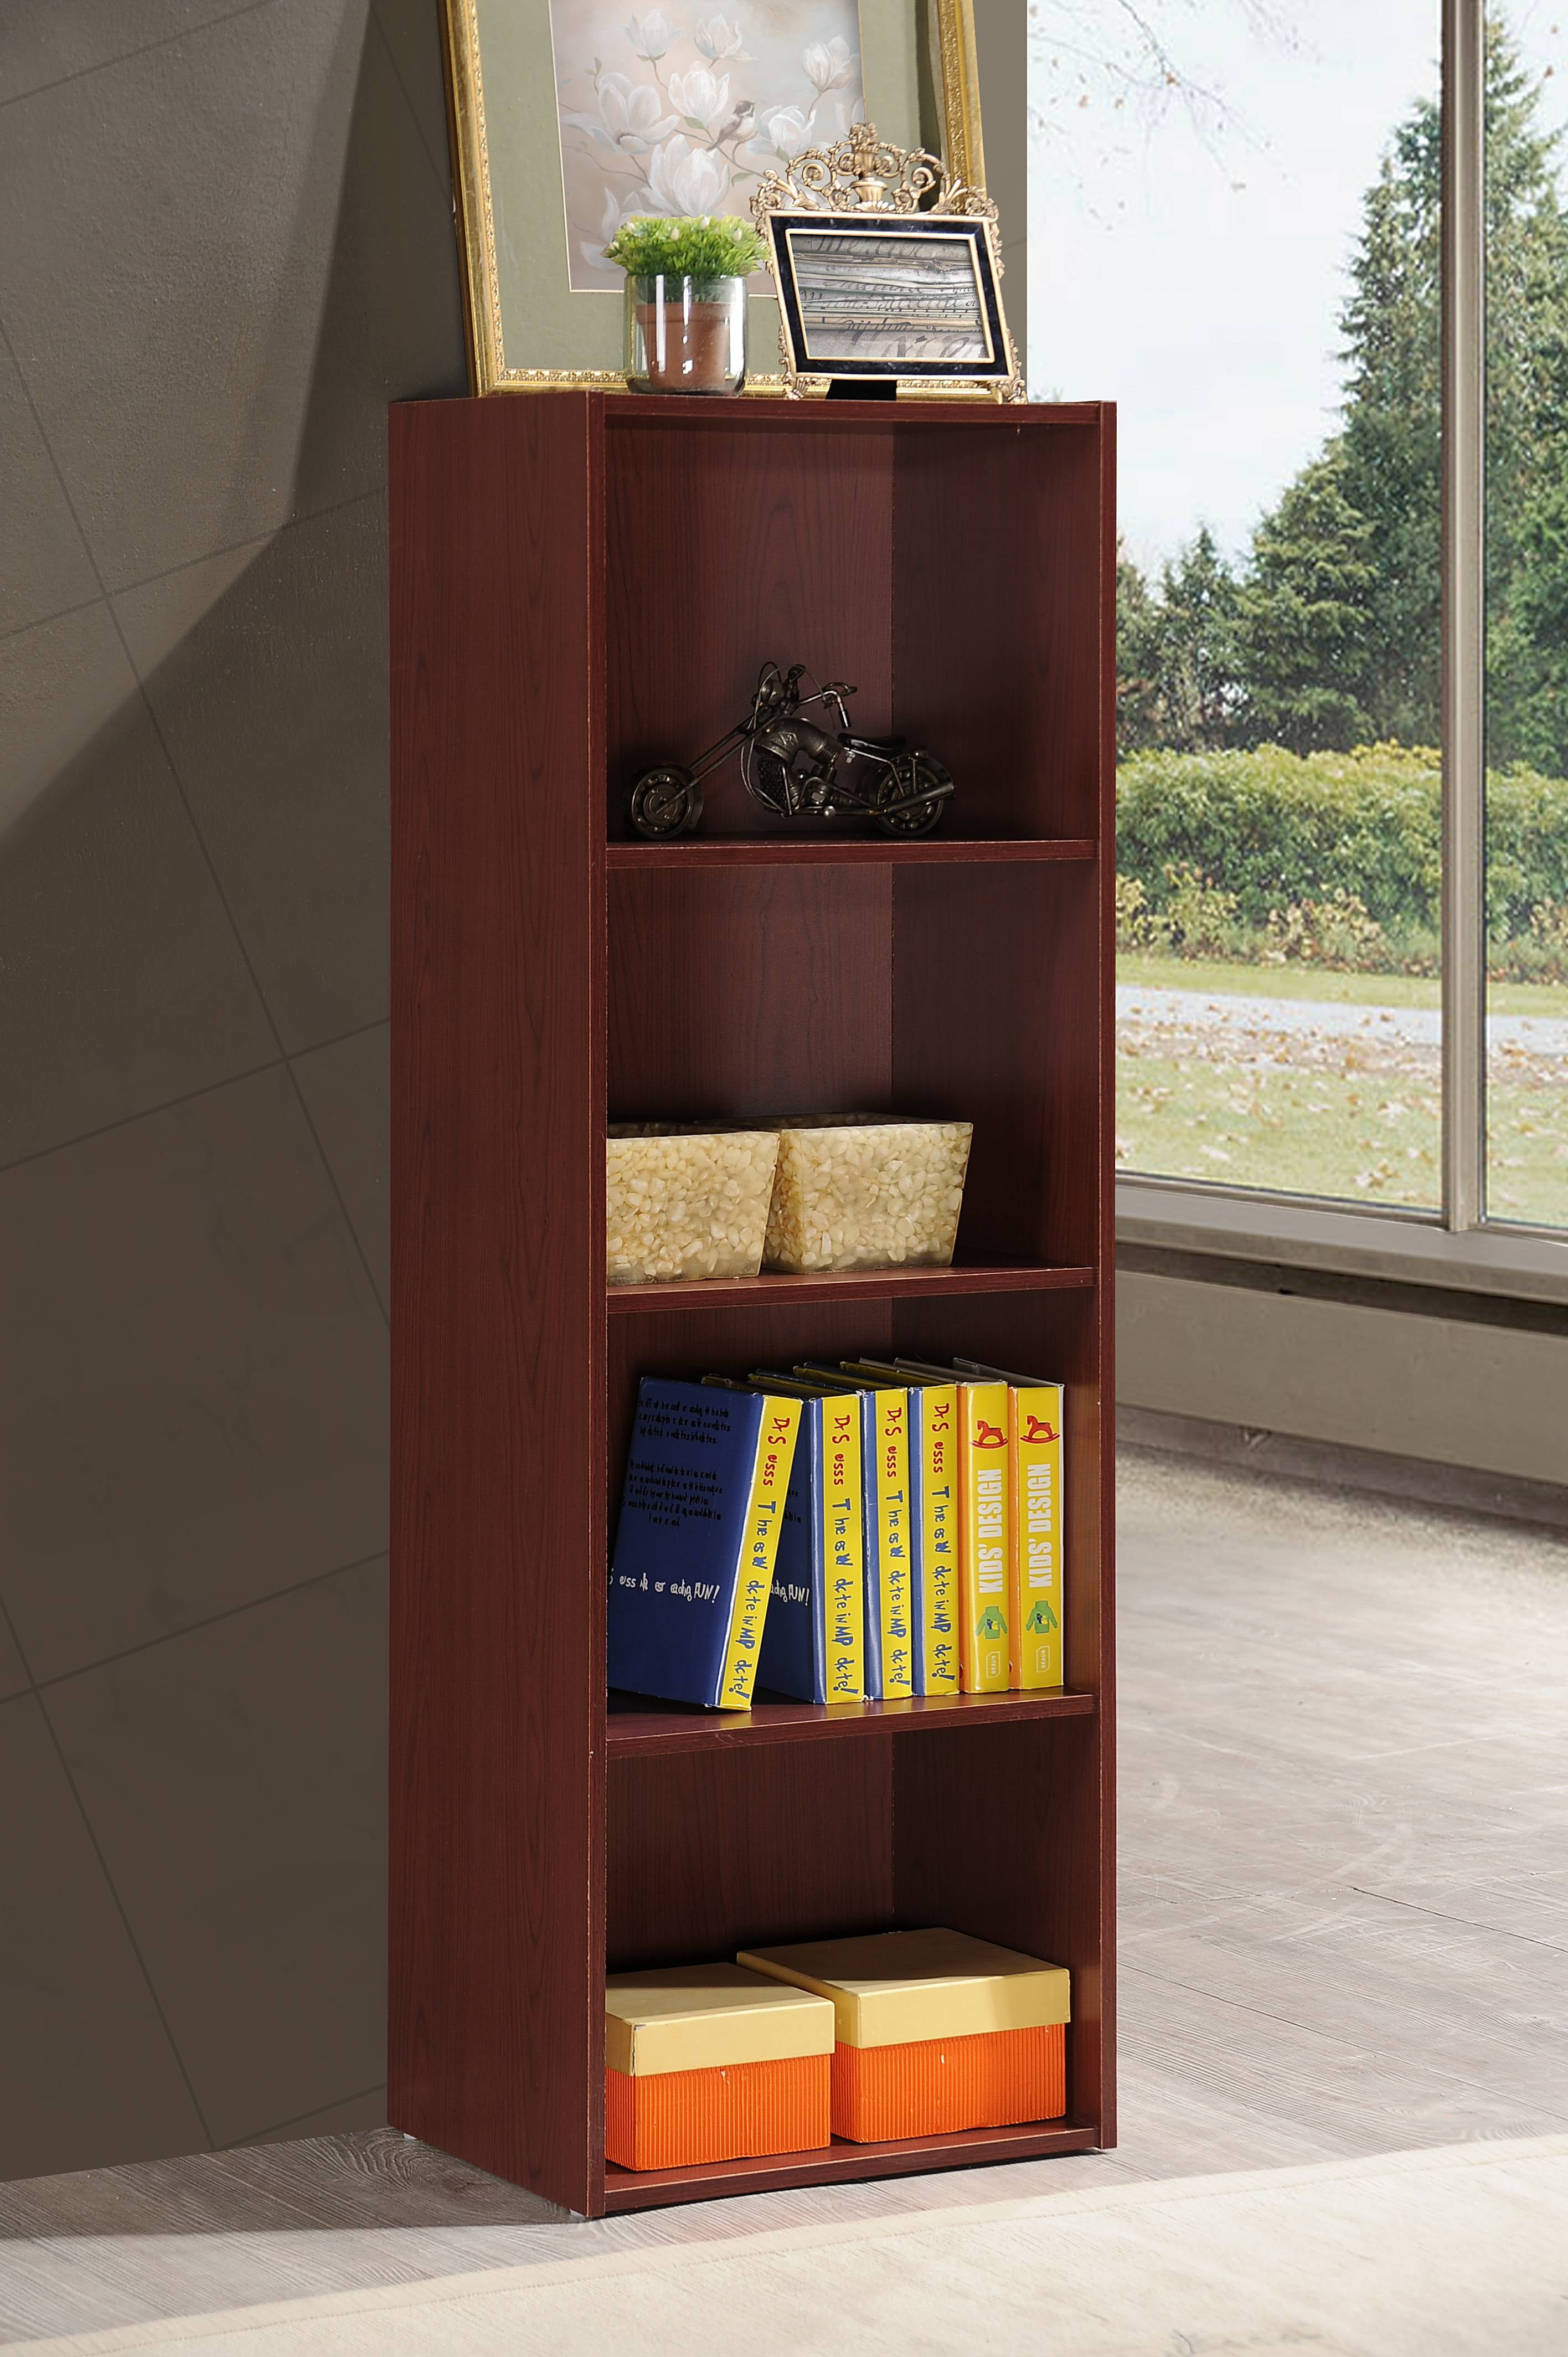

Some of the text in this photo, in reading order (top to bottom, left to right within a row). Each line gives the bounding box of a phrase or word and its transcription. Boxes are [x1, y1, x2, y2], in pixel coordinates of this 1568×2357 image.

[886, 1407, 902, 1423] Dr
[933, 1402, 950, 1419] Dr
[771, 1417, 790, 1433] Dr
[834, 1414, 850, 1431] Dr
[977, 1469, 1003, 1593] KIDS' DESIGN
[1027, 1464, 1052, 1588] KIDS' DESIGN
[693, 1582, 720, 1604] FUN!
[788, 1584, 810, 1606] FUN!
